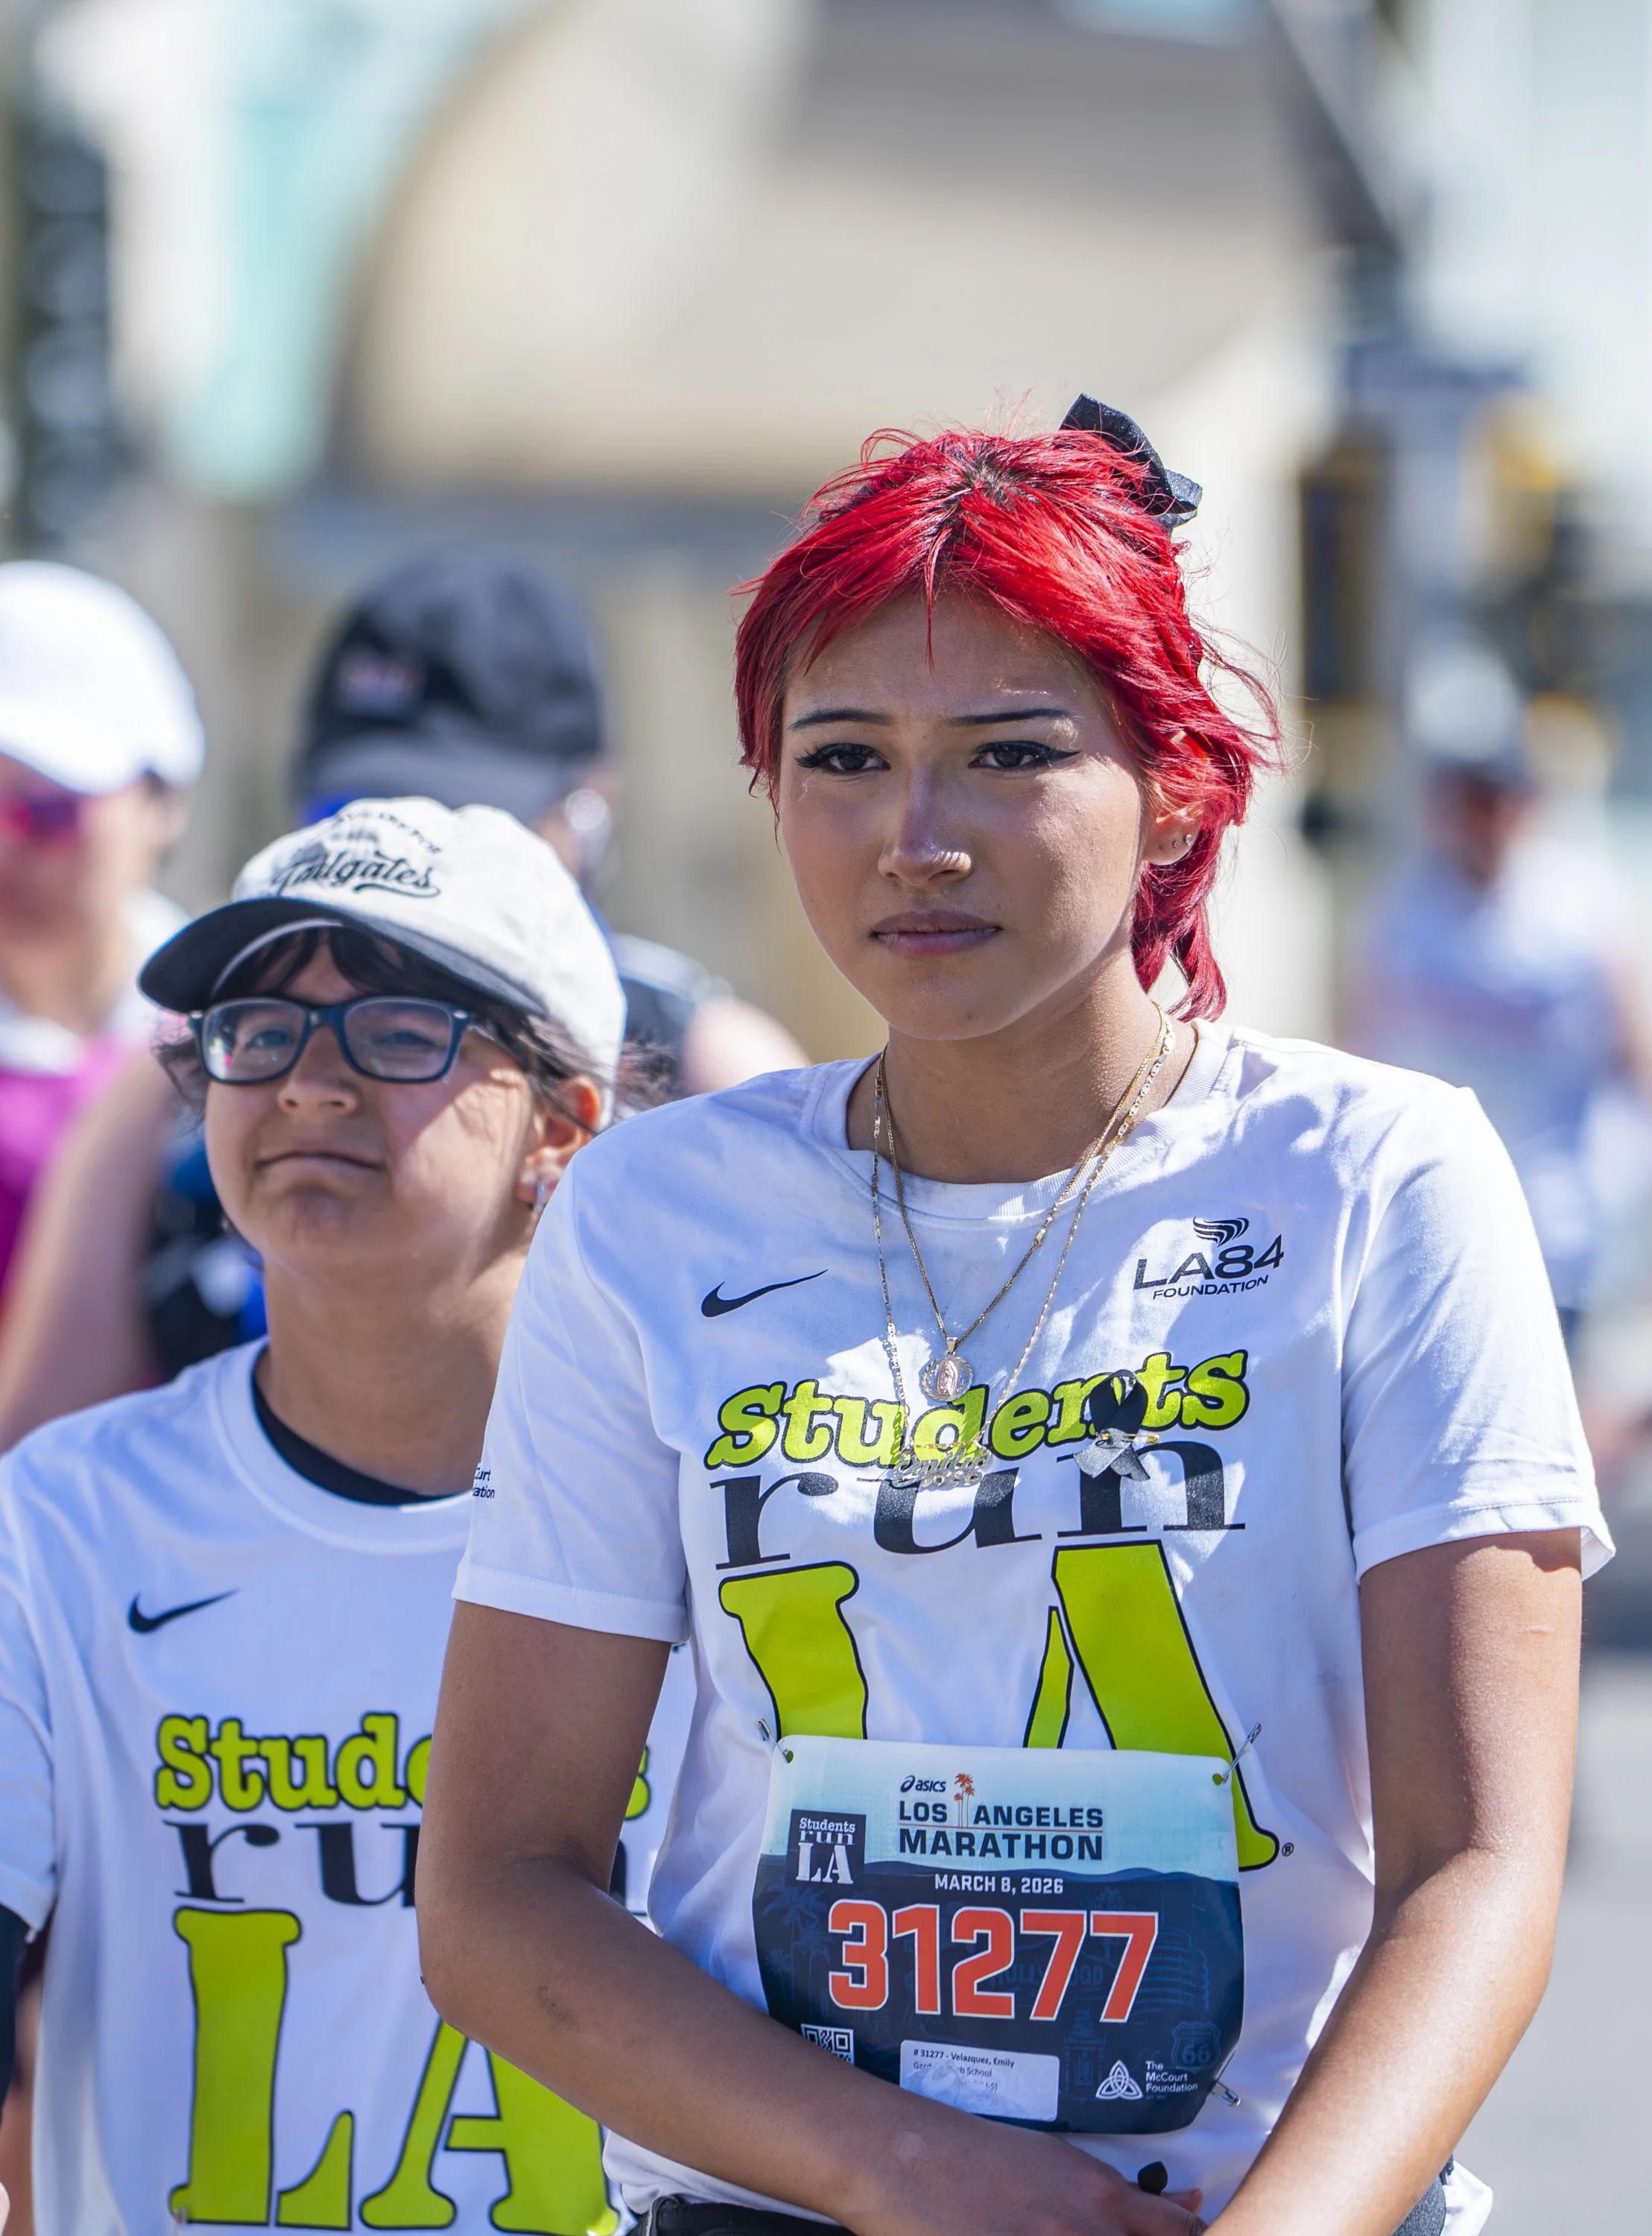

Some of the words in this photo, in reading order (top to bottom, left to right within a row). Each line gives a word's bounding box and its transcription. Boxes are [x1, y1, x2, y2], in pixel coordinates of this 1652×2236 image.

[270, 850, 440, 897] Tailgates
[1133, 1234, 1284, 1290] LA84
[1153, 1275, 1268, 1300] FOUNDATION
[472, 1483, 496, 1500] ation
[709, 1440, 1246, 1570] run
[799, 1816, 856, 1834] Students
[899, 1800, 948, 1823] LOS
[972, 1804, 1104, 1828] ANGELES
[800, 1830, 855, 1845] run
[899, 1828, 1103, 1861] MARATHON
[795, 1842, 854, 1884] LA
[934, 1873, 996, 1892] MARCH
[1001, 1877, 1016, 1896] 8,
[1021, 1877, 1064, 1895] 2026
[828, 1898, 1159, 2024] 31277
[169, 1906, 621, 2235] LA
[920, 2049, 945, 2059] 31277
[951, 2052, 992, 2066] Velazquez,
[993, 2058, 1015, 2069] Emily
[1145, 2061, 1164, 2071] The
[966, 2067, 993, 2078] School
[1145, 2072, 1188, 2082] McCourt
[1145, 2083, 1198, 2094] Foundation
